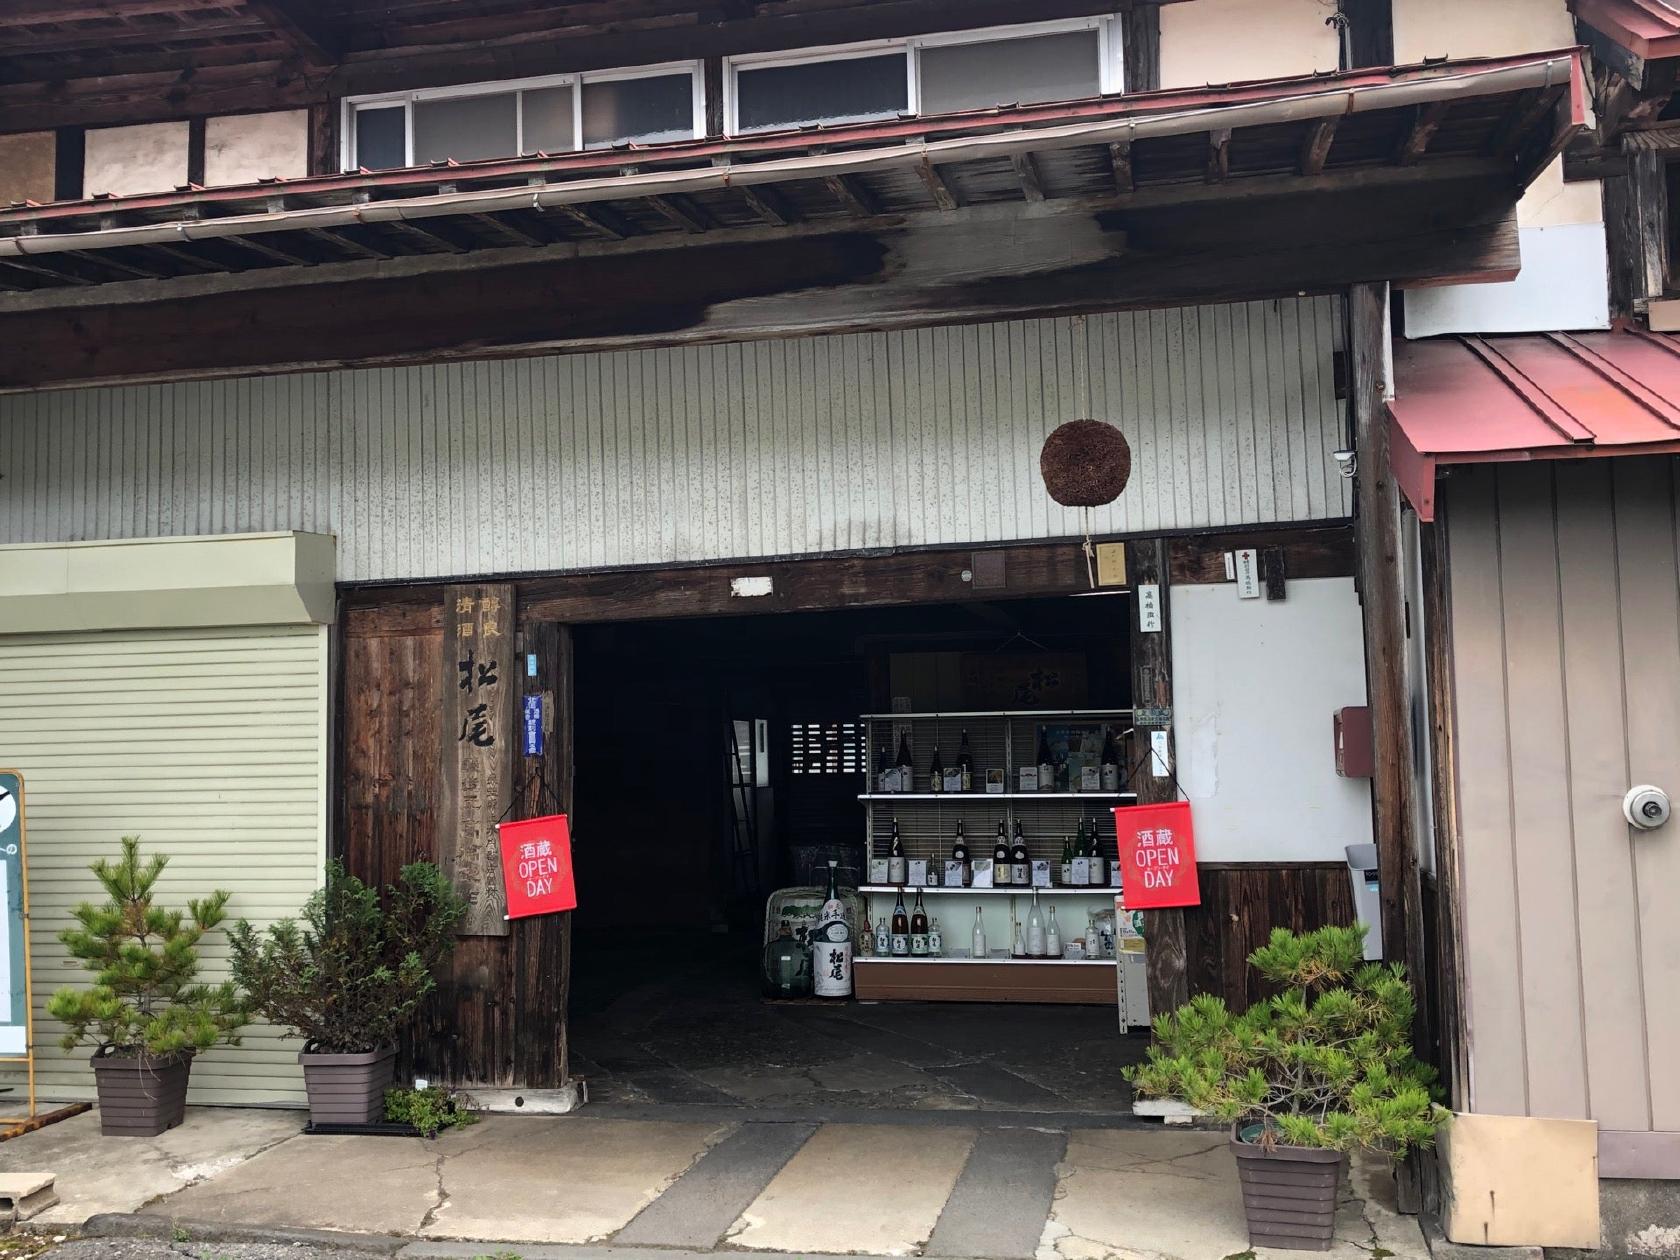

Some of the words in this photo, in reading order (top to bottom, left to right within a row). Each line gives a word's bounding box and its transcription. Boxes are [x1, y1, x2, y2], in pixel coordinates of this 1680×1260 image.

[456, 596, 475, 638] 清酒
[458, 648, 498, 747] 松尾
[1136, 829, 1173, 847] 酒蔵
[520, 840, 552, 859] 酒蔵
[1135, 848, 1180, 867] OPEN
[519, 857, 558, 878] OPEN
[526, 878, 553, 897] DAY
[1144, 869, 1173, 888] DAY
[829, 949, 844, 981] 松尾
